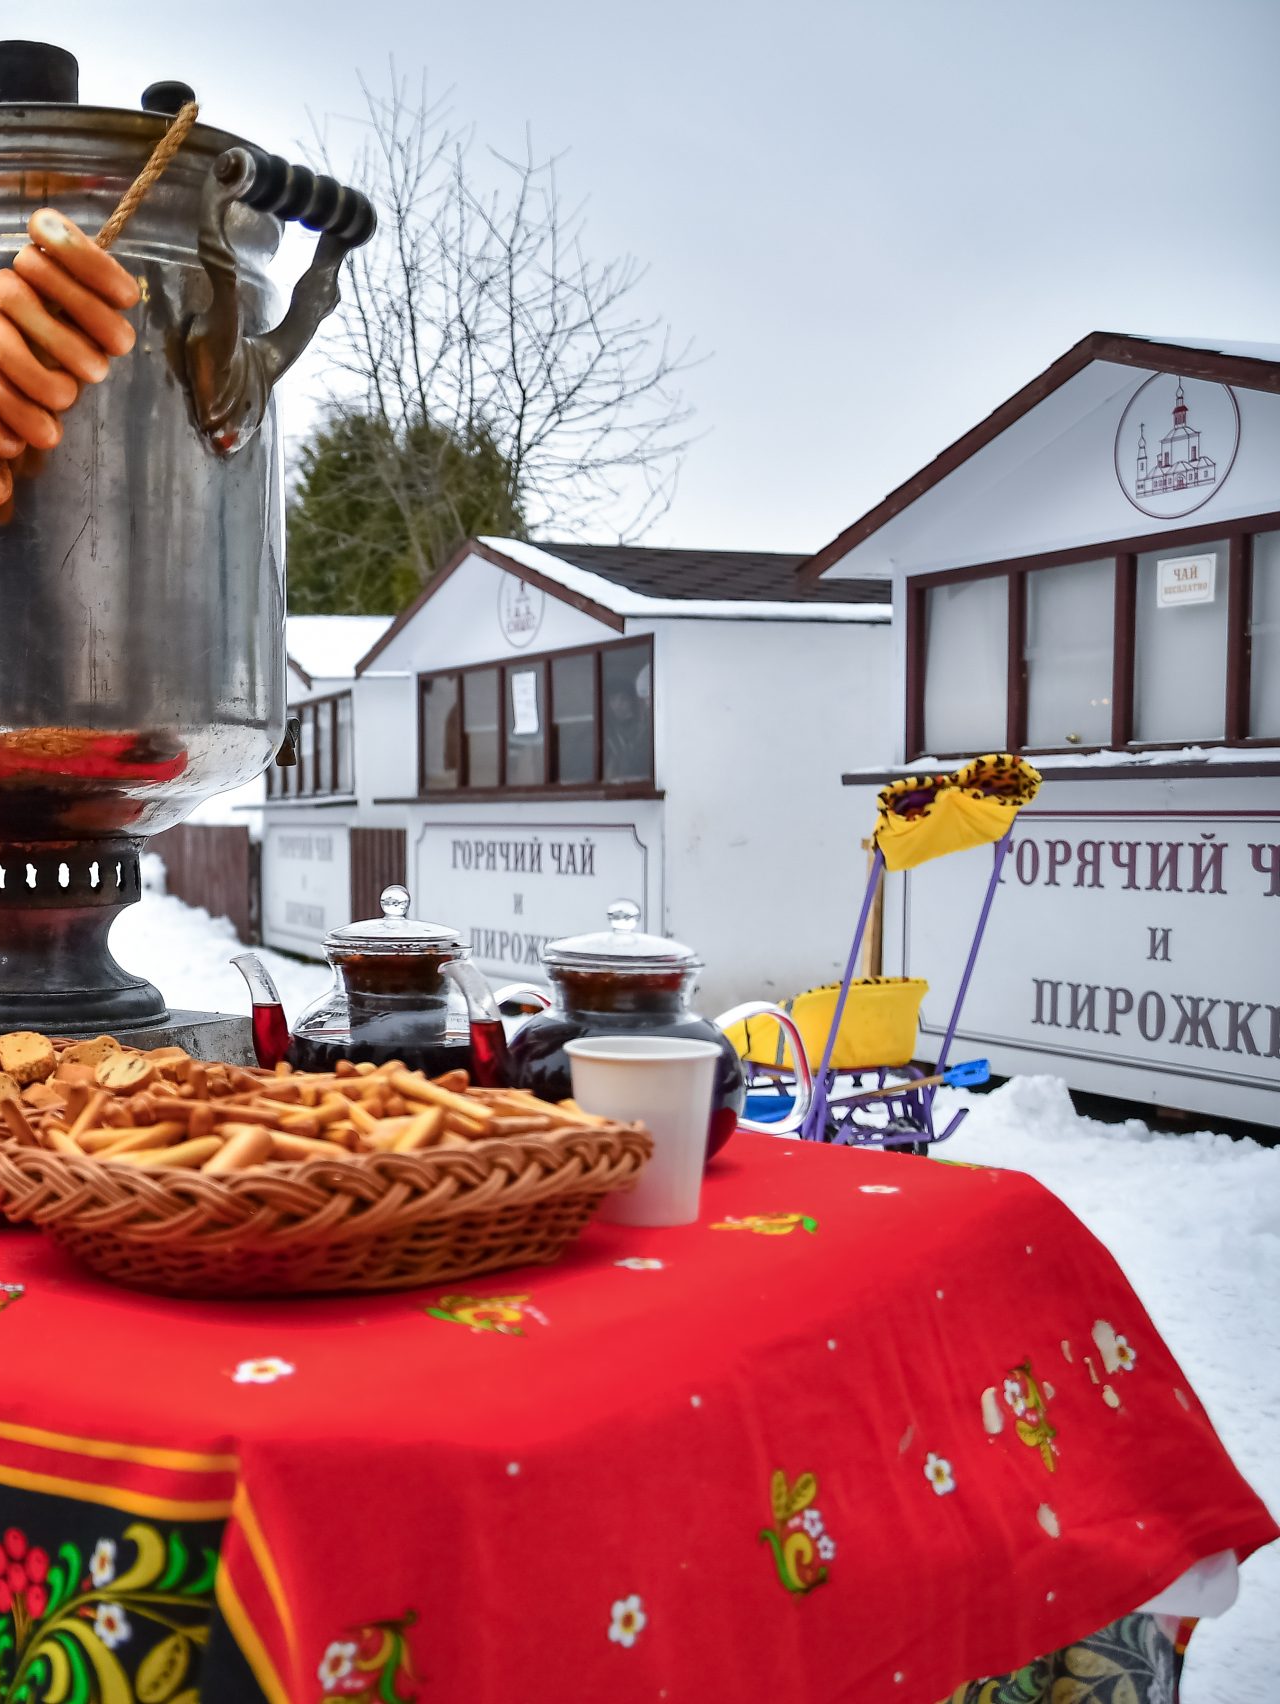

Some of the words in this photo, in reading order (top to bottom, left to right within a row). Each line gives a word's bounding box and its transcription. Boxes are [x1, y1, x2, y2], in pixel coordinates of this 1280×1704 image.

[1173, 564, 1198, 581] ЧАЙ
[452, 837, 543, 874] ГОРЯЧИЙ
[550, 837, 596, 876] ЧАЙ
[470, 928, 560, 966] ПИРОЖ
[1146, 926, 1173, 962] И
